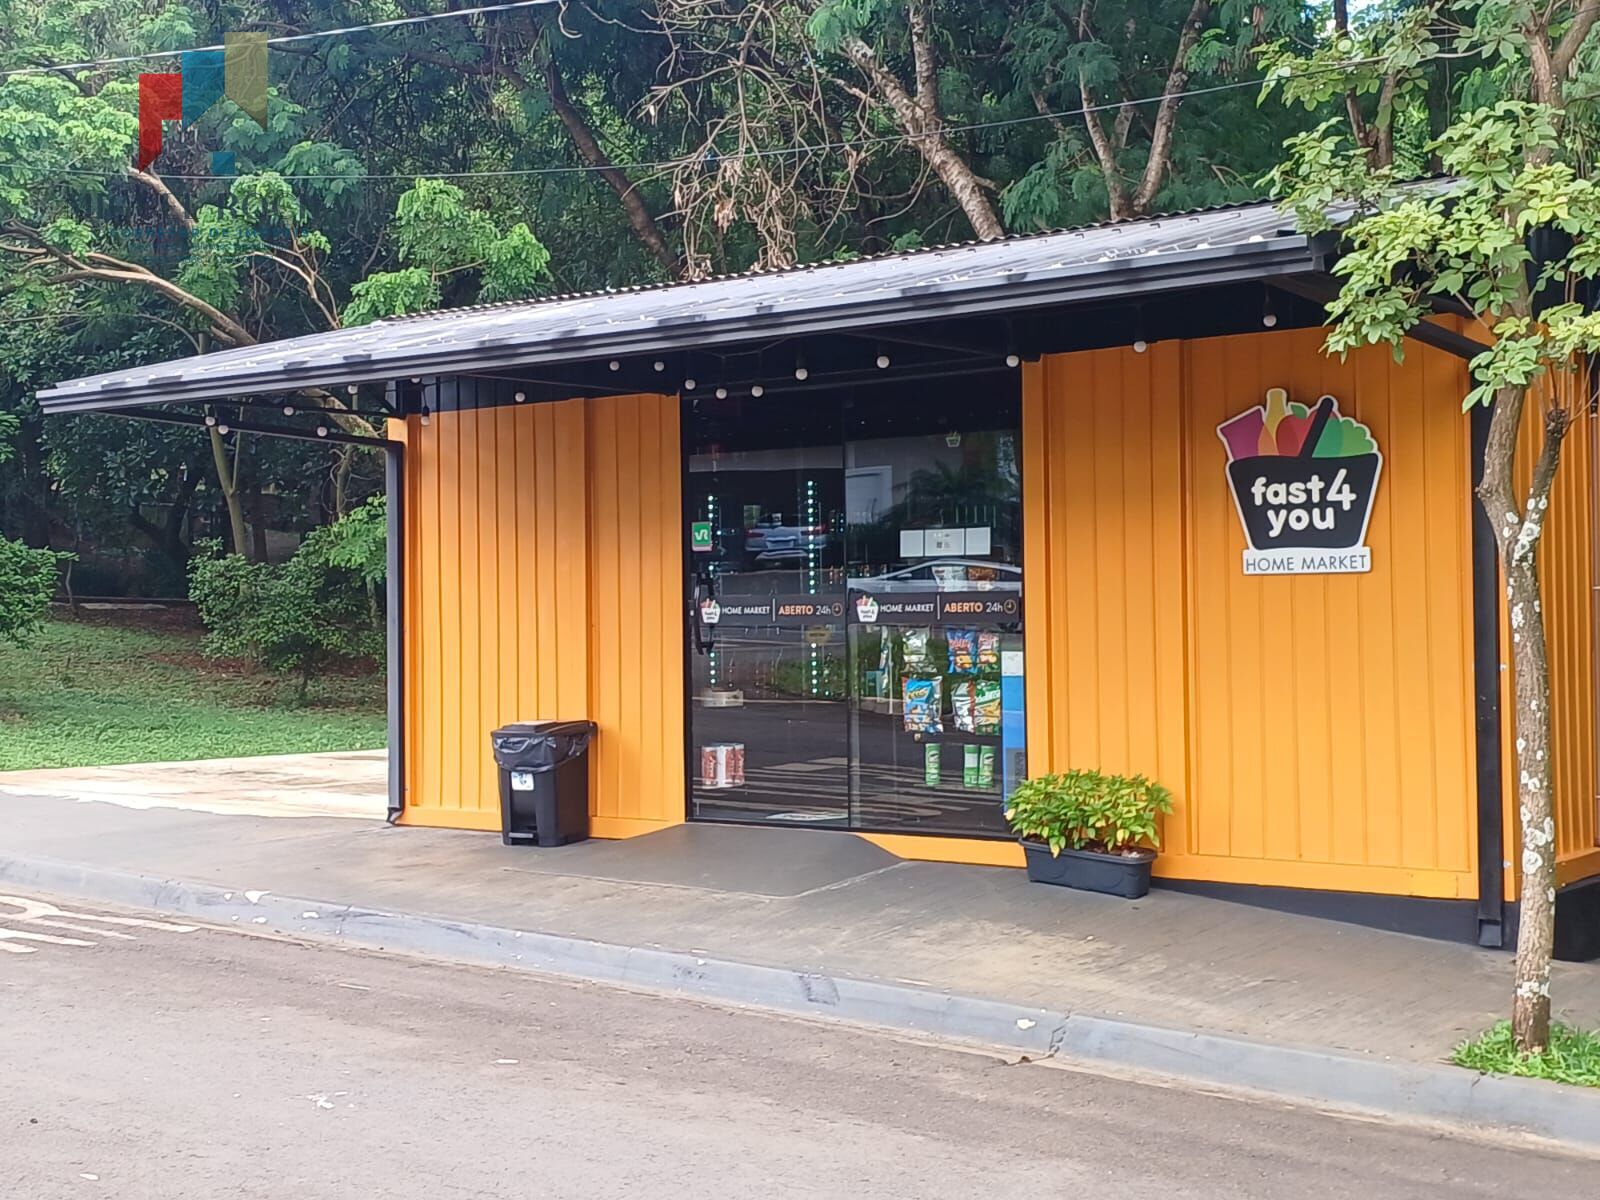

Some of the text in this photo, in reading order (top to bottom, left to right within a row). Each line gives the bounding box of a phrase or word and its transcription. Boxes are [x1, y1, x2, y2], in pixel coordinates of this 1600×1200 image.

[1266, 507, 1335, 538] you
[1246, 554, 1368, 572] HOME MARKET
[721, 606, 832, 616] HOME MARKET ABERTO 24h
[880, 602, 1004, 613] HOME MARKET ABERTO 24h
